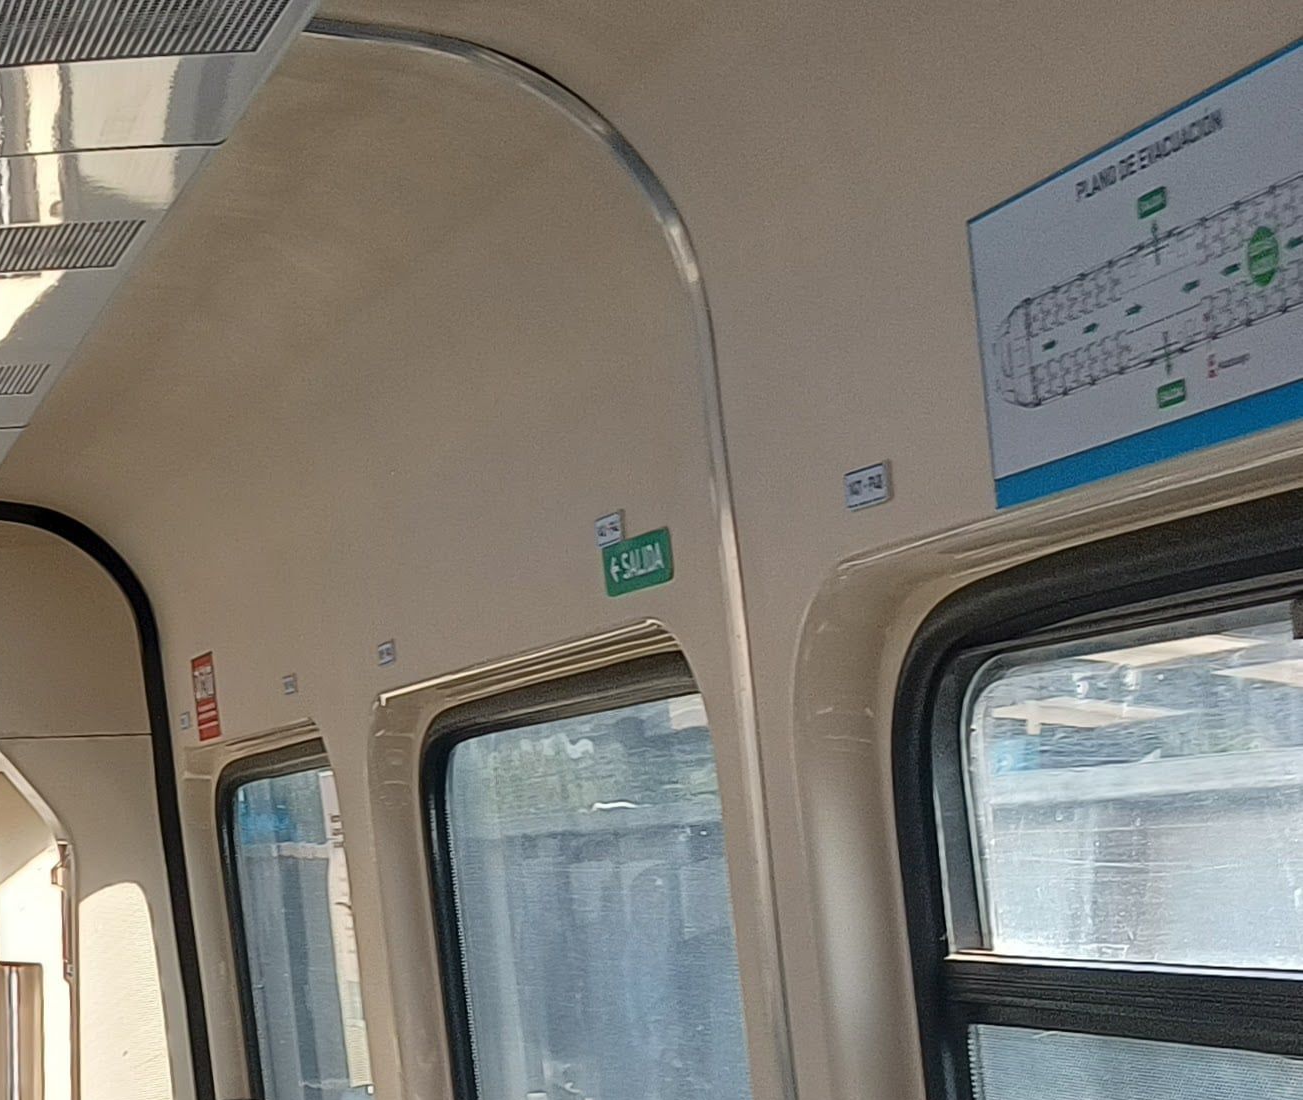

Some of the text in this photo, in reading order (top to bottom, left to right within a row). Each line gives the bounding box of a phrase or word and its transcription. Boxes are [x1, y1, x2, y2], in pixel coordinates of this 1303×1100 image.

[1075, 165, 1117, 202] PLANO
[1119, 153, 1137, 180] DE
[620, 542, 665, 579] SALIDA
